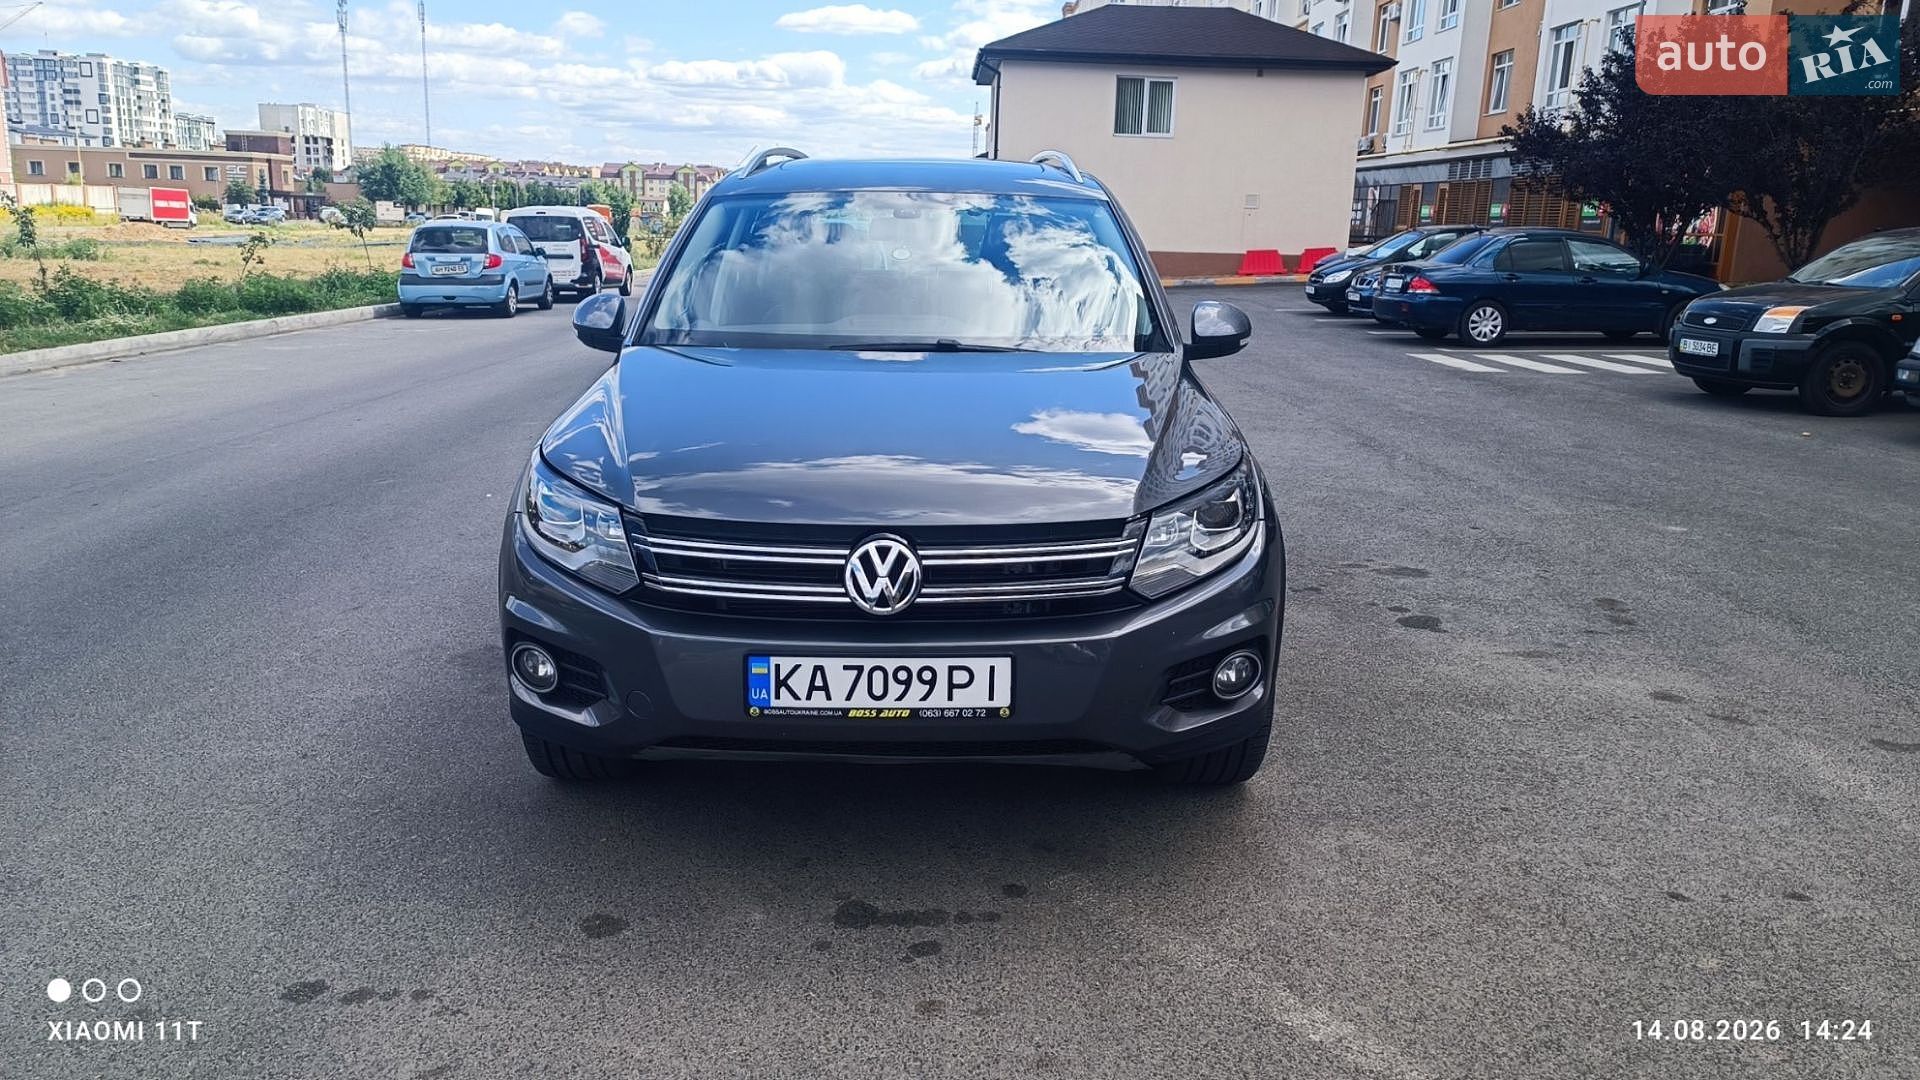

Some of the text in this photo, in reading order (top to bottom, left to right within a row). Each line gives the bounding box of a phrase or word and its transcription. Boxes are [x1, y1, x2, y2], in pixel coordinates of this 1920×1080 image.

[774, 663, 996, 702] KA 7099 PI
[751, 687, 768, 700] UA
[848, 709, 911, 717] BOSS AUTO
[918, 709, 986, 718] (063) 667 02 72
